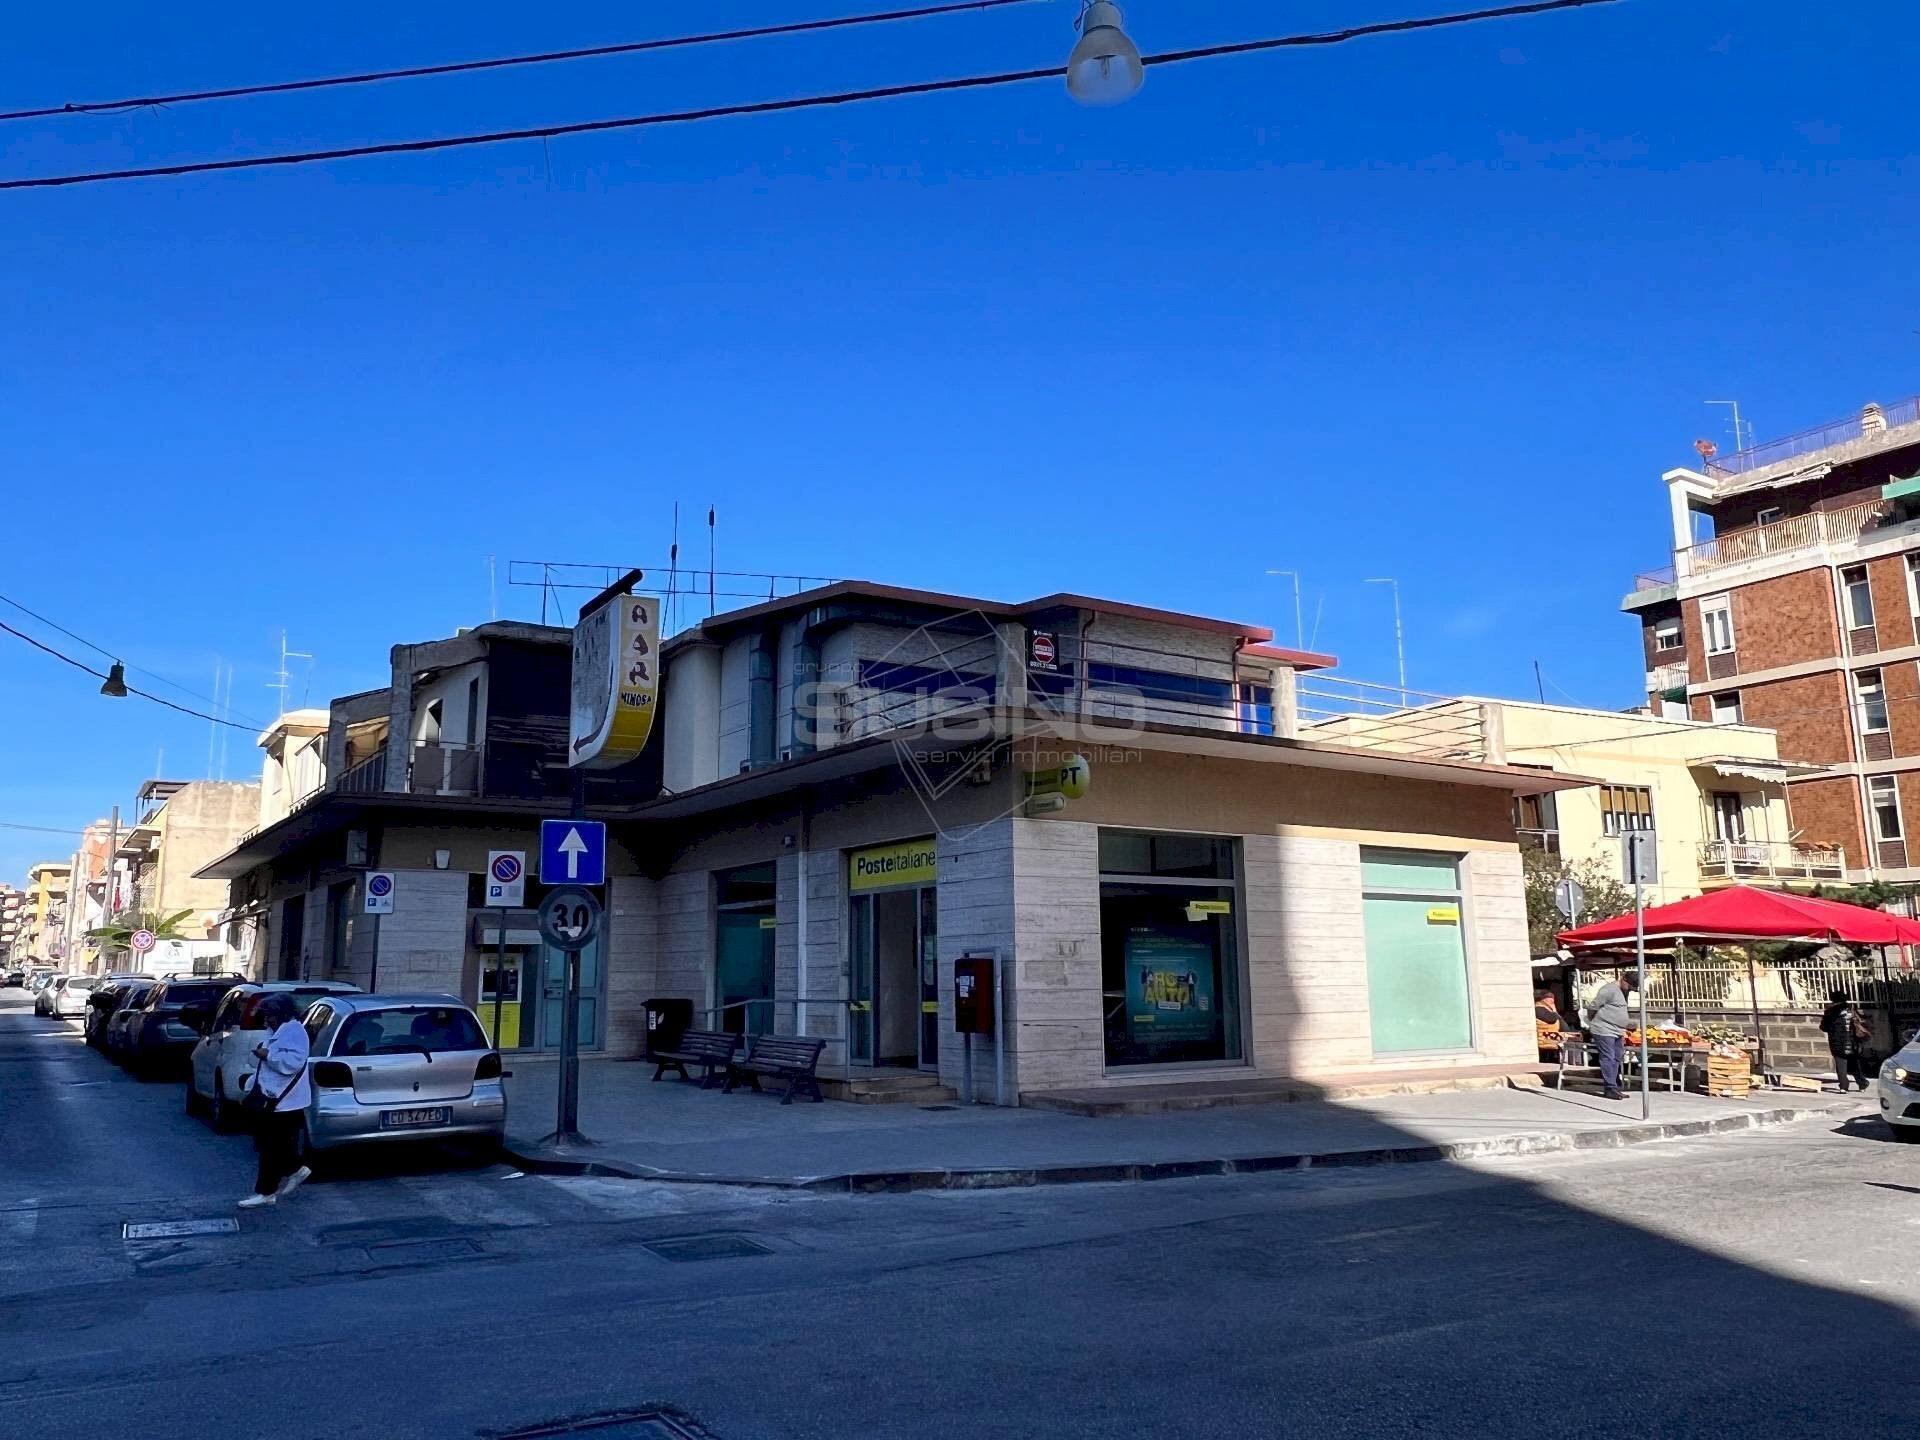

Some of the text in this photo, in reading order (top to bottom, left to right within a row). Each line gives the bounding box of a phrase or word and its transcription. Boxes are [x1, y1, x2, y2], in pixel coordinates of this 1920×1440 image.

[621, 691, 652, 707] MIMOSA
[1061, 766, 1081, 788] PT
[553, 903, 589, 935] 30
